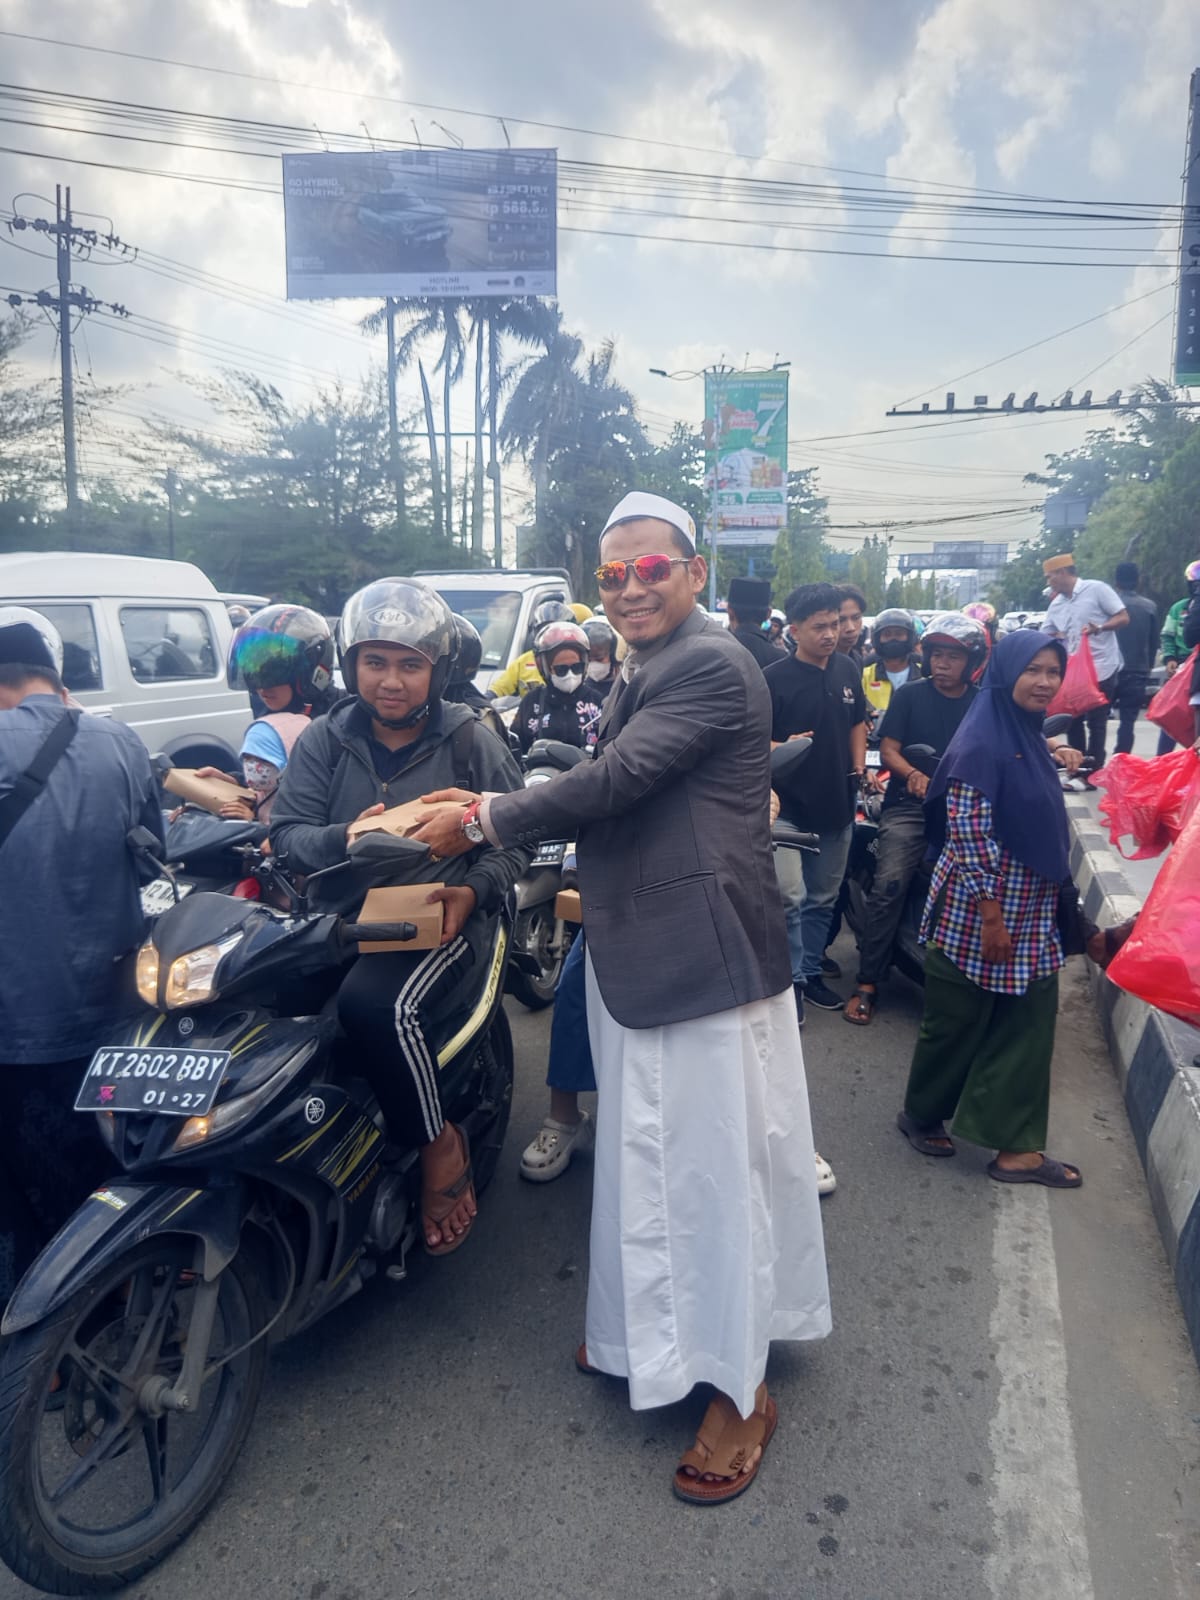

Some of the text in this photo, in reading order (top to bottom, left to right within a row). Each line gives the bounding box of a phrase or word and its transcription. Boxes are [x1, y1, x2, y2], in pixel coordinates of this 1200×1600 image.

[91, 1053, 224, 1081] KT 2602 BBY
